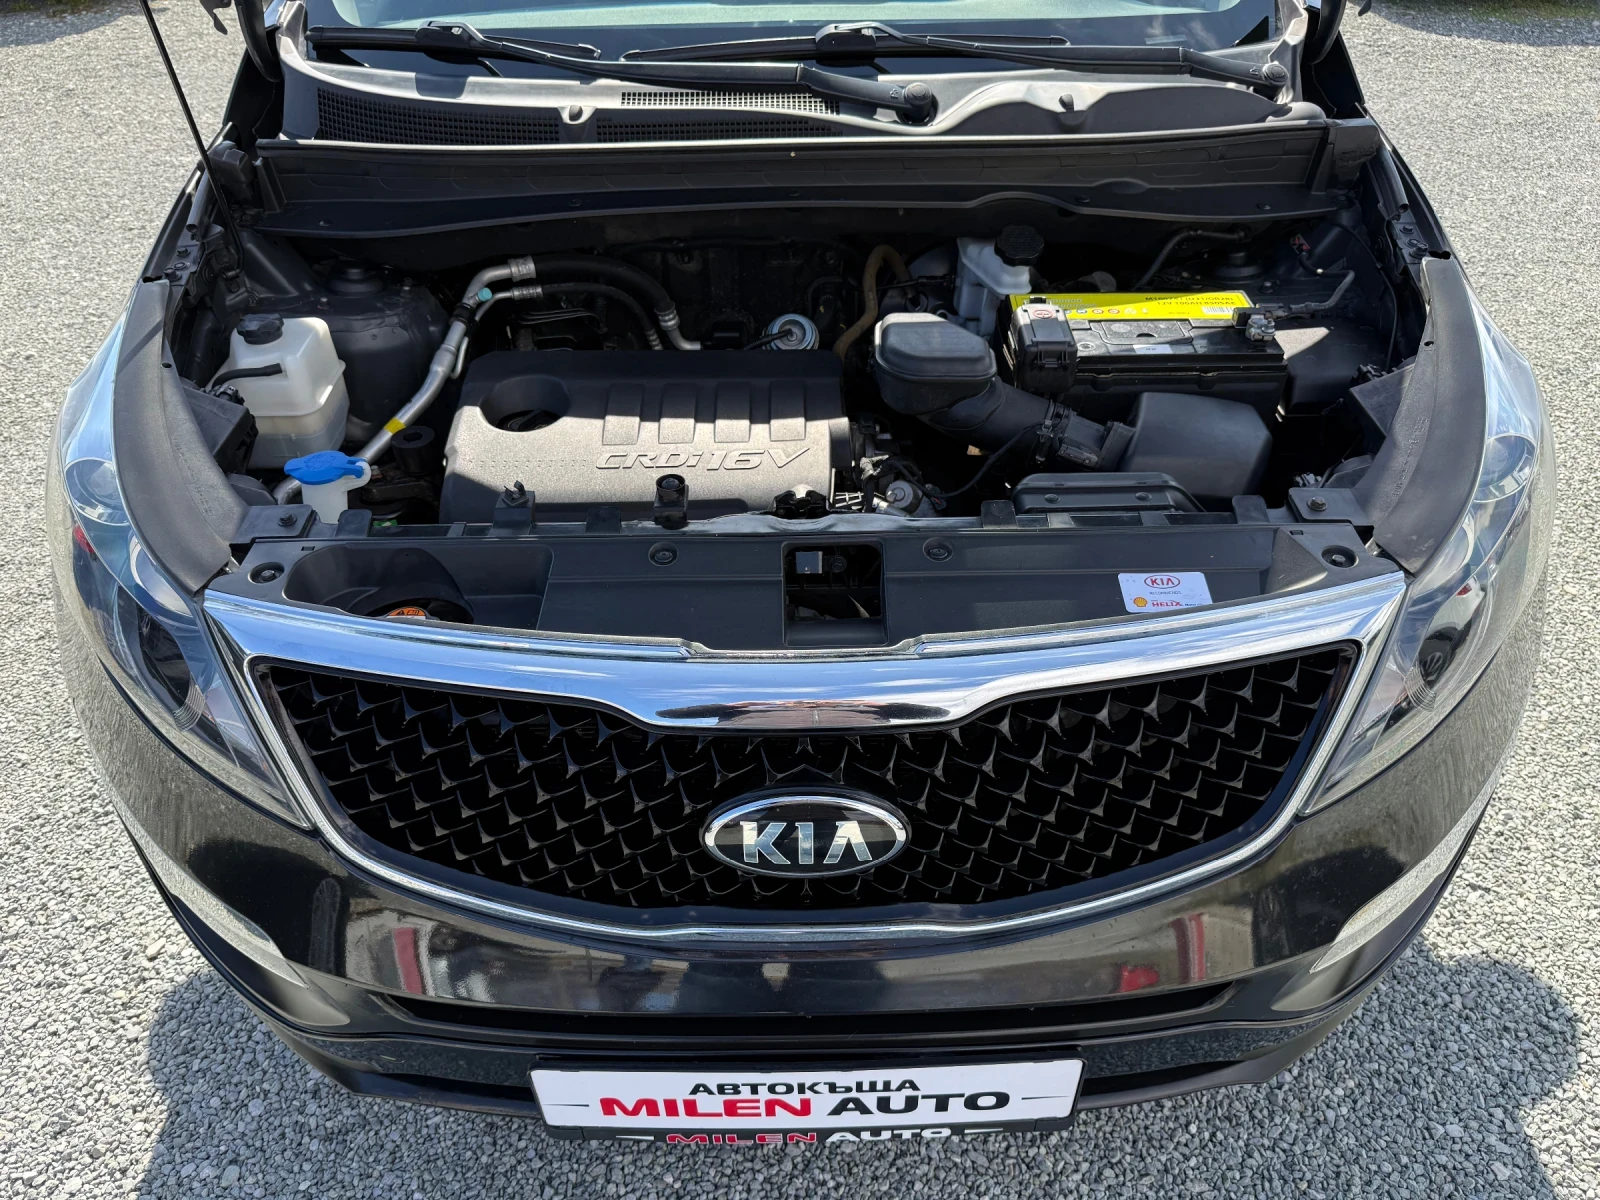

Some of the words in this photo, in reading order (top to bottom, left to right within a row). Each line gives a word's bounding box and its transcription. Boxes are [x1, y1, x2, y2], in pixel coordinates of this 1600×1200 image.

[1150, 577, 1175, 586] KIA
[739, 820, 873, 865] KIA
[688, 1079, 921, 1096] АВТОКЪША
[599, 1097, 812, 1118] MILEN
[826, 1091, 1010, 1117] AUTO
[666, 1132, 817, 1145] MILEN
[825, 1128, 952, 1143] AUTO
